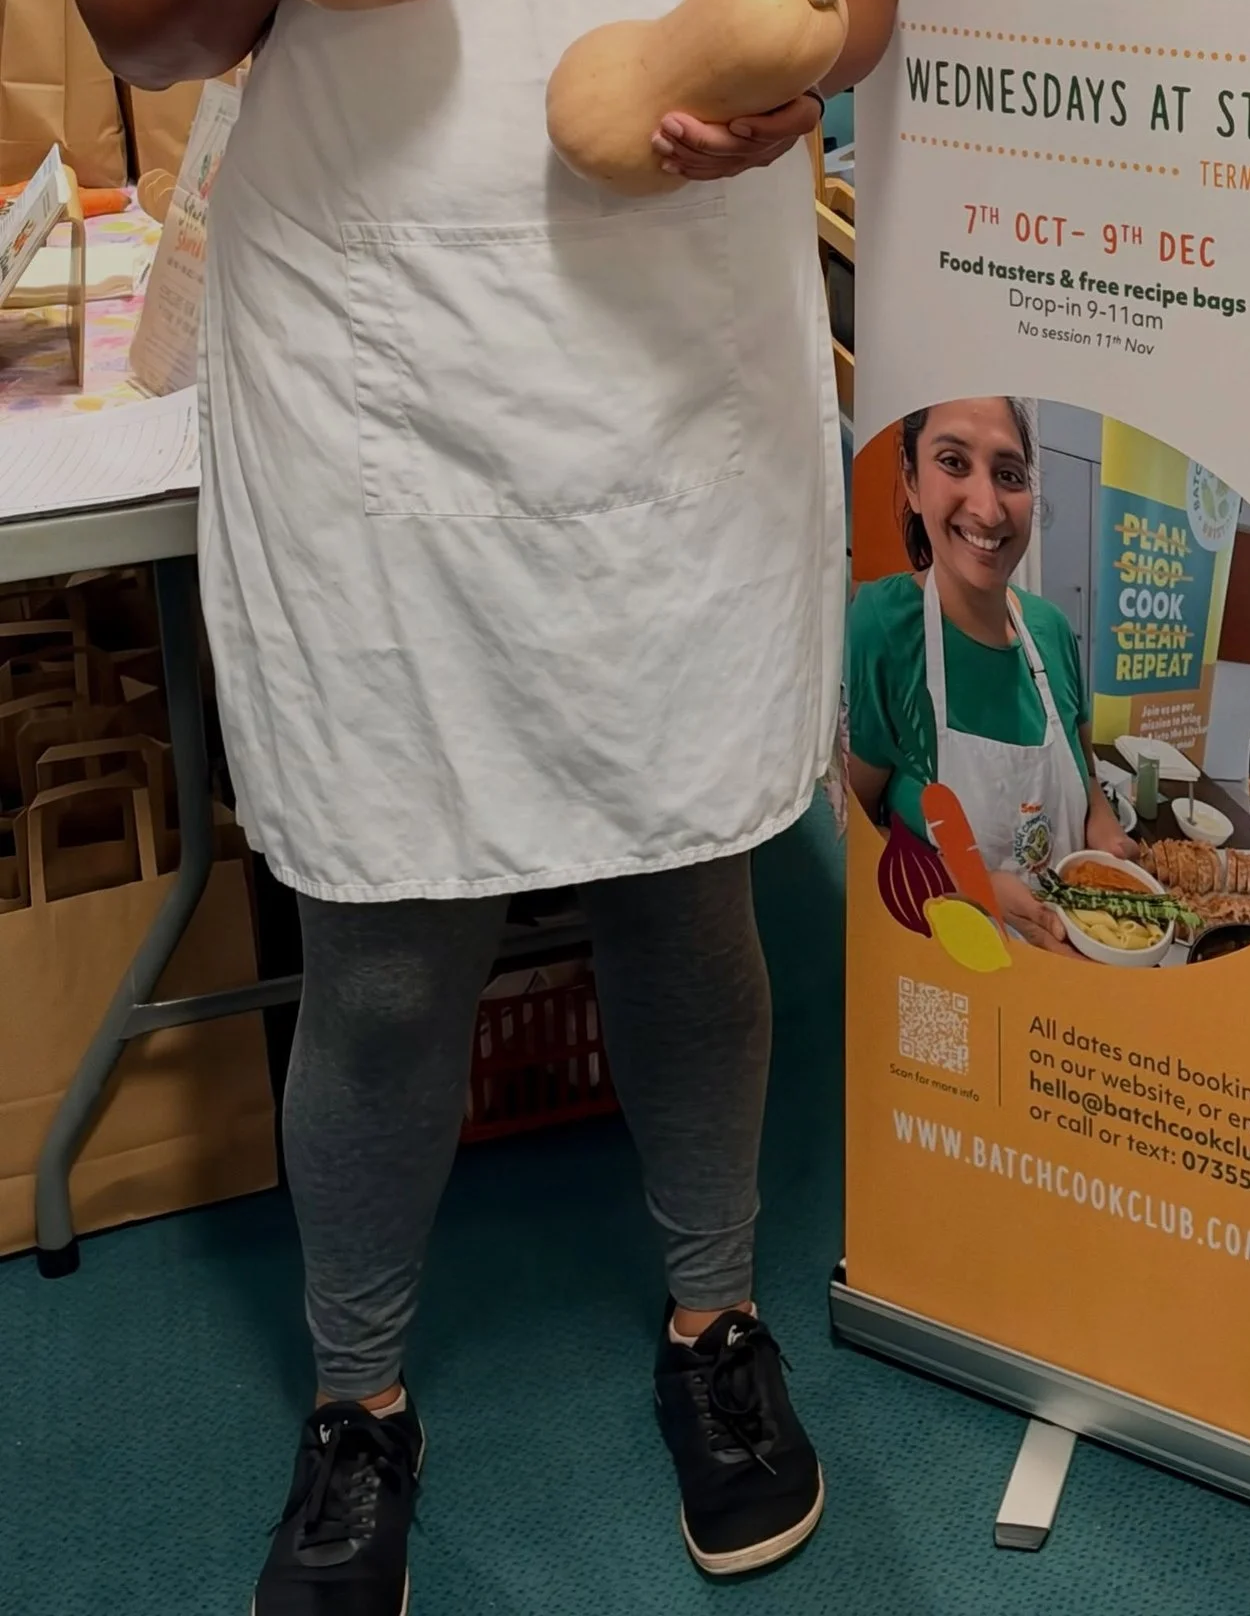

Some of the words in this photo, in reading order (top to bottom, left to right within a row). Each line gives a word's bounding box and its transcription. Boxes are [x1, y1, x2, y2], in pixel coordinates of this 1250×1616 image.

[906, 57, 1127, 127] WEDNESDAYS
[1150, 84, 1191, 133] AT
[1160, 231, 1215, 267] DEC
[940, 251, 984, 276] Food
[988, 261, 1055, 287] tasters
[1060, 269, 1074, 289] &
[1079, 271, 1119, 296] free
[1124, 282, 1188, 309] recipe
[1193, 287, 1246, 317] bags
[1010, 288, 1081, 317] Drop-in
[1087, 300, 1163, 330] 9-11am
[1018, 320, 1038, 336] No
[1042, 328, 1091, 345] session
[1096, 333, 1121, 348] 11th
[1125, 337, 1155, 355] Nov
[1122, 513, 1187, 558] PLAN
[1120, 552, 1184, 589] SHOP
[1118, 588, 1185, 620] COOK
[1117, 622, 1187, 650] CLEAN
[1116, 653, 1193, 681] REPEAT
[1029, 1016, 1056, 1040] All
[1062, 1026, 1122, 1062] dates
[1128, 1052, 1170, 1077] and
[890, 1063, 913, 1080] Scan
[915, 1071, 929, 1085] for
[932, 1080, 958, 1095] more
[960, 1088, 979, 1102] info
[1029, 1049, 1054, 1068] on
[1060, 1059, 1096, 1080] our
[1101, 1071, 1191, 1116] website,
[1198, 1103, 1222, 1121] or
[1029, 1106, 1052, 1122] or
[1057, 1114, 1093, 1138] call
[1099, 1129, 1122, 1147] or
[1127, 1134, 1176, 1165] text:
